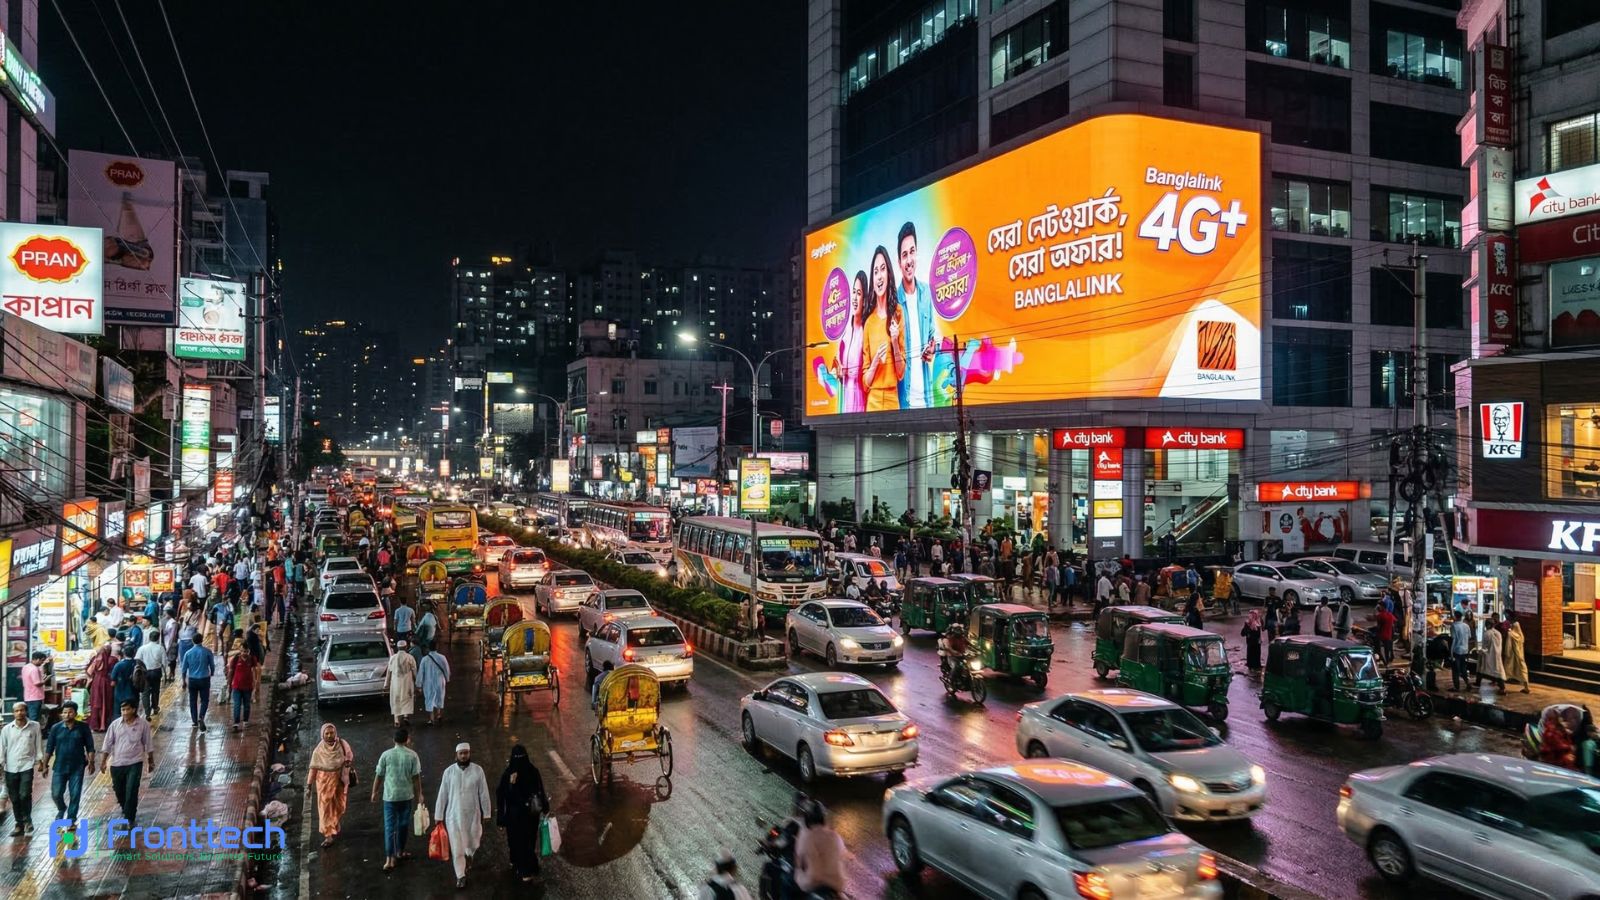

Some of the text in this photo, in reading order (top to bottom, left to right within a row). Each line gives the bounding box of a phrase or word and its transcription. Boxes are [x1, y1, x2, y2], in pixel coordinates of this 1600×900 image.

[109, 168, 141, 180] PRAN
[1145, 166, 1223, 191] Banglalink
[1492, 171, 1507, 180] KFC
[1542, 193, 1600, 214] city bank
[987, 187, 1129, 253] সেরা নেটওয়ার্ক,
[1137, 191, 1248, 255] 4G+
[21, 250, 77, 267] PRAN
[1008, 247, 1045, 280] সেরা
[1050, 231, 1124, 269] অফার!
[1014, 273, 1124, 309] BANGLALINK
[1490, 283, 1512, 296] KFC
[3, 295, 95, 319] কাপ্রান
[1197, 372, 1236, 381] BANGLALINK
[1074, 431, 1114, 446] city bank
[1178, 431, 1227, 446] city bank
[1488, 444, 1517, 455] KFC
[1295, 485, 1338, 499] city bank
